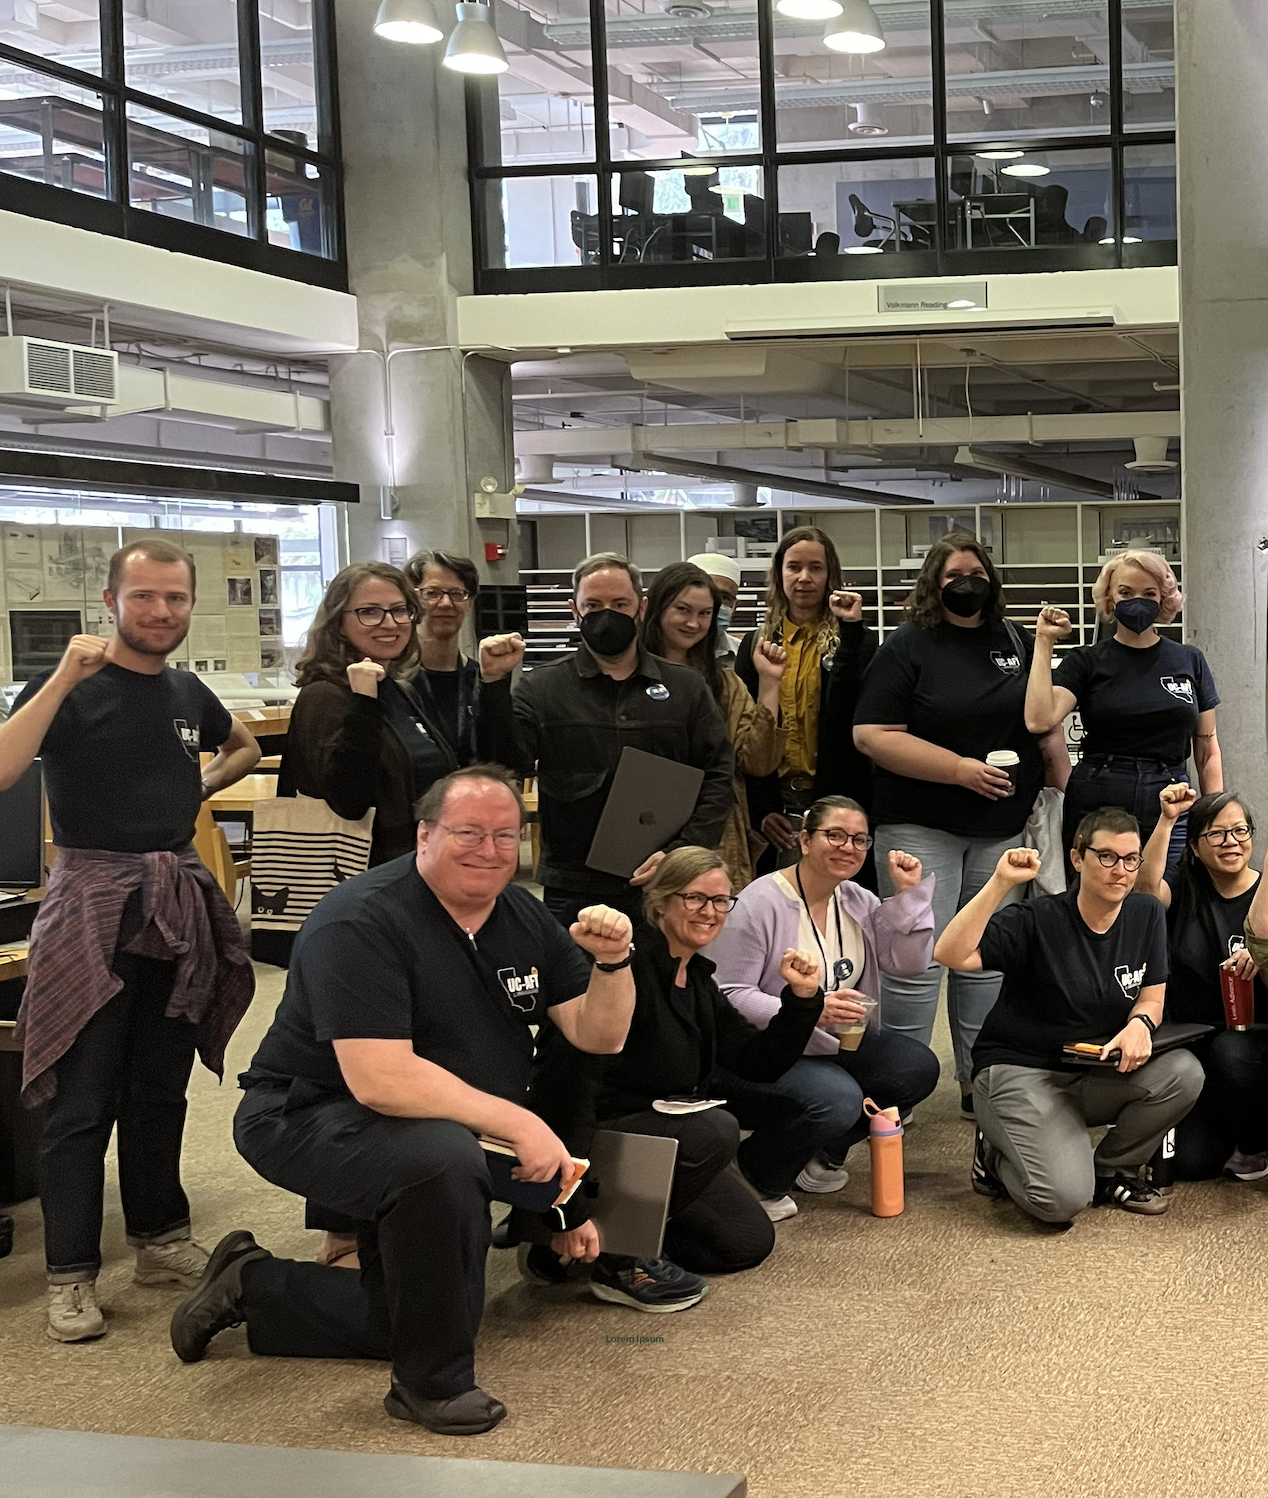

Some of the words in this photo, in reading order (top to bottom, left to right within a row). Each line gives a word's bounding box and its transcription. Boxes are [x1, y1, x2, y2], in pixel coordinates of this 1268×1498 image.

[920, 301, 948, 309] Reading
[507, 974, 539, 993] UC-AFT
[1228, 975, 1236, 1003] Advance
